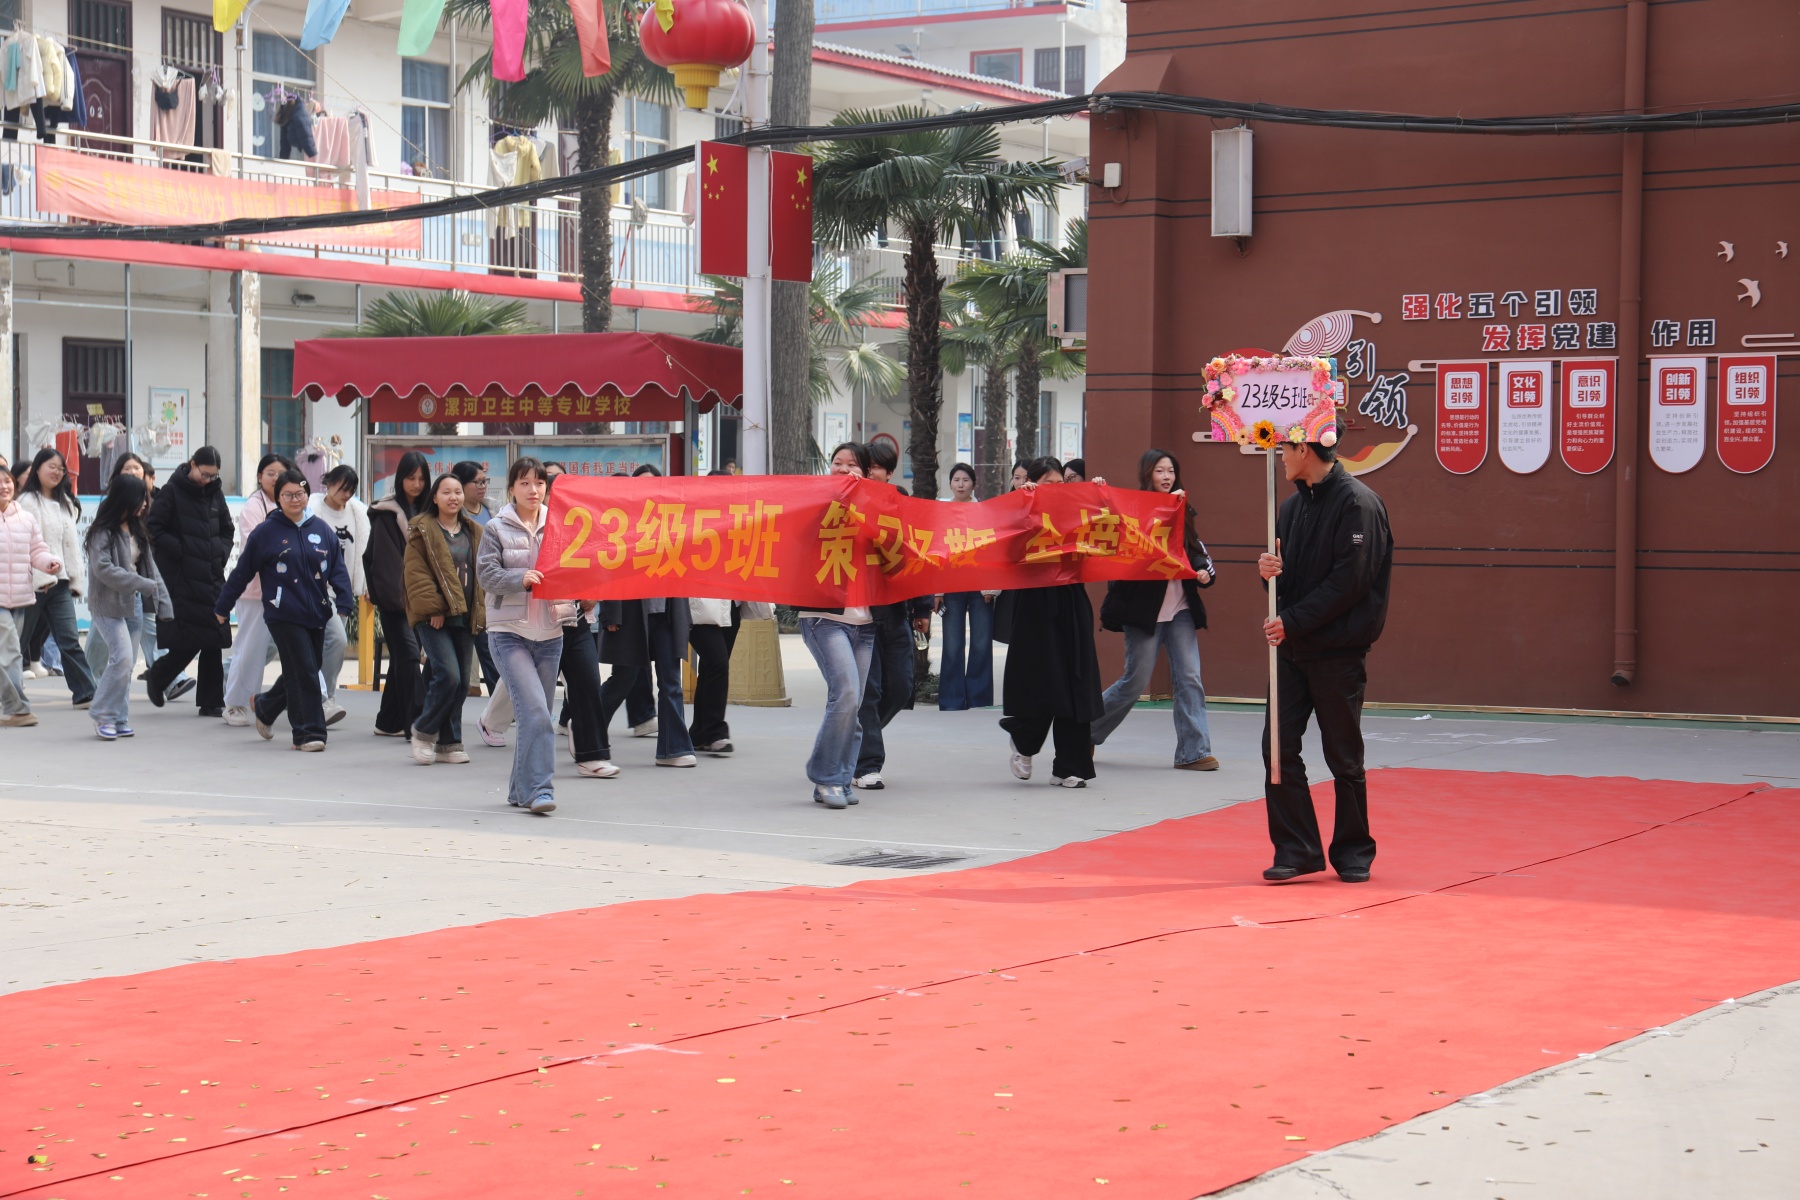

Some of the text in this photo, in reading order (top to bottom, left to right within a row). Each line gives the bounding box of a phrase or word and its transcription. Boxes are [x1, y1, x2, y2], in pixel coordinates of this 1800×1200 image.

[1402, 289, 1597, 321] 强化五个引领
[1482, 318, 1716, 351] 发挥党建 作用
[1450, 377, 1473, 390] 思想
[1512, 376, 1537, 389] 文化
[1577, 375, 1601, 388] 意识
[1665, 372, 1691, 386] 创新
[1734, 371, 1760, 385] 组织
[1241, 383, 1308, 410] 23级5班
[1450, 391, 1473, 404] 引领
[1512, 391, 1536, 404] 引领
[1577, 390, 1601, 403] 引领
[1665, 387, 1691, 401] 引领
[1735, 387, 1760, 400] 引领
[444, 396, 631, 417] 漯河卫生中等专业学校
[559, 499, 782, 582] 23级5班
